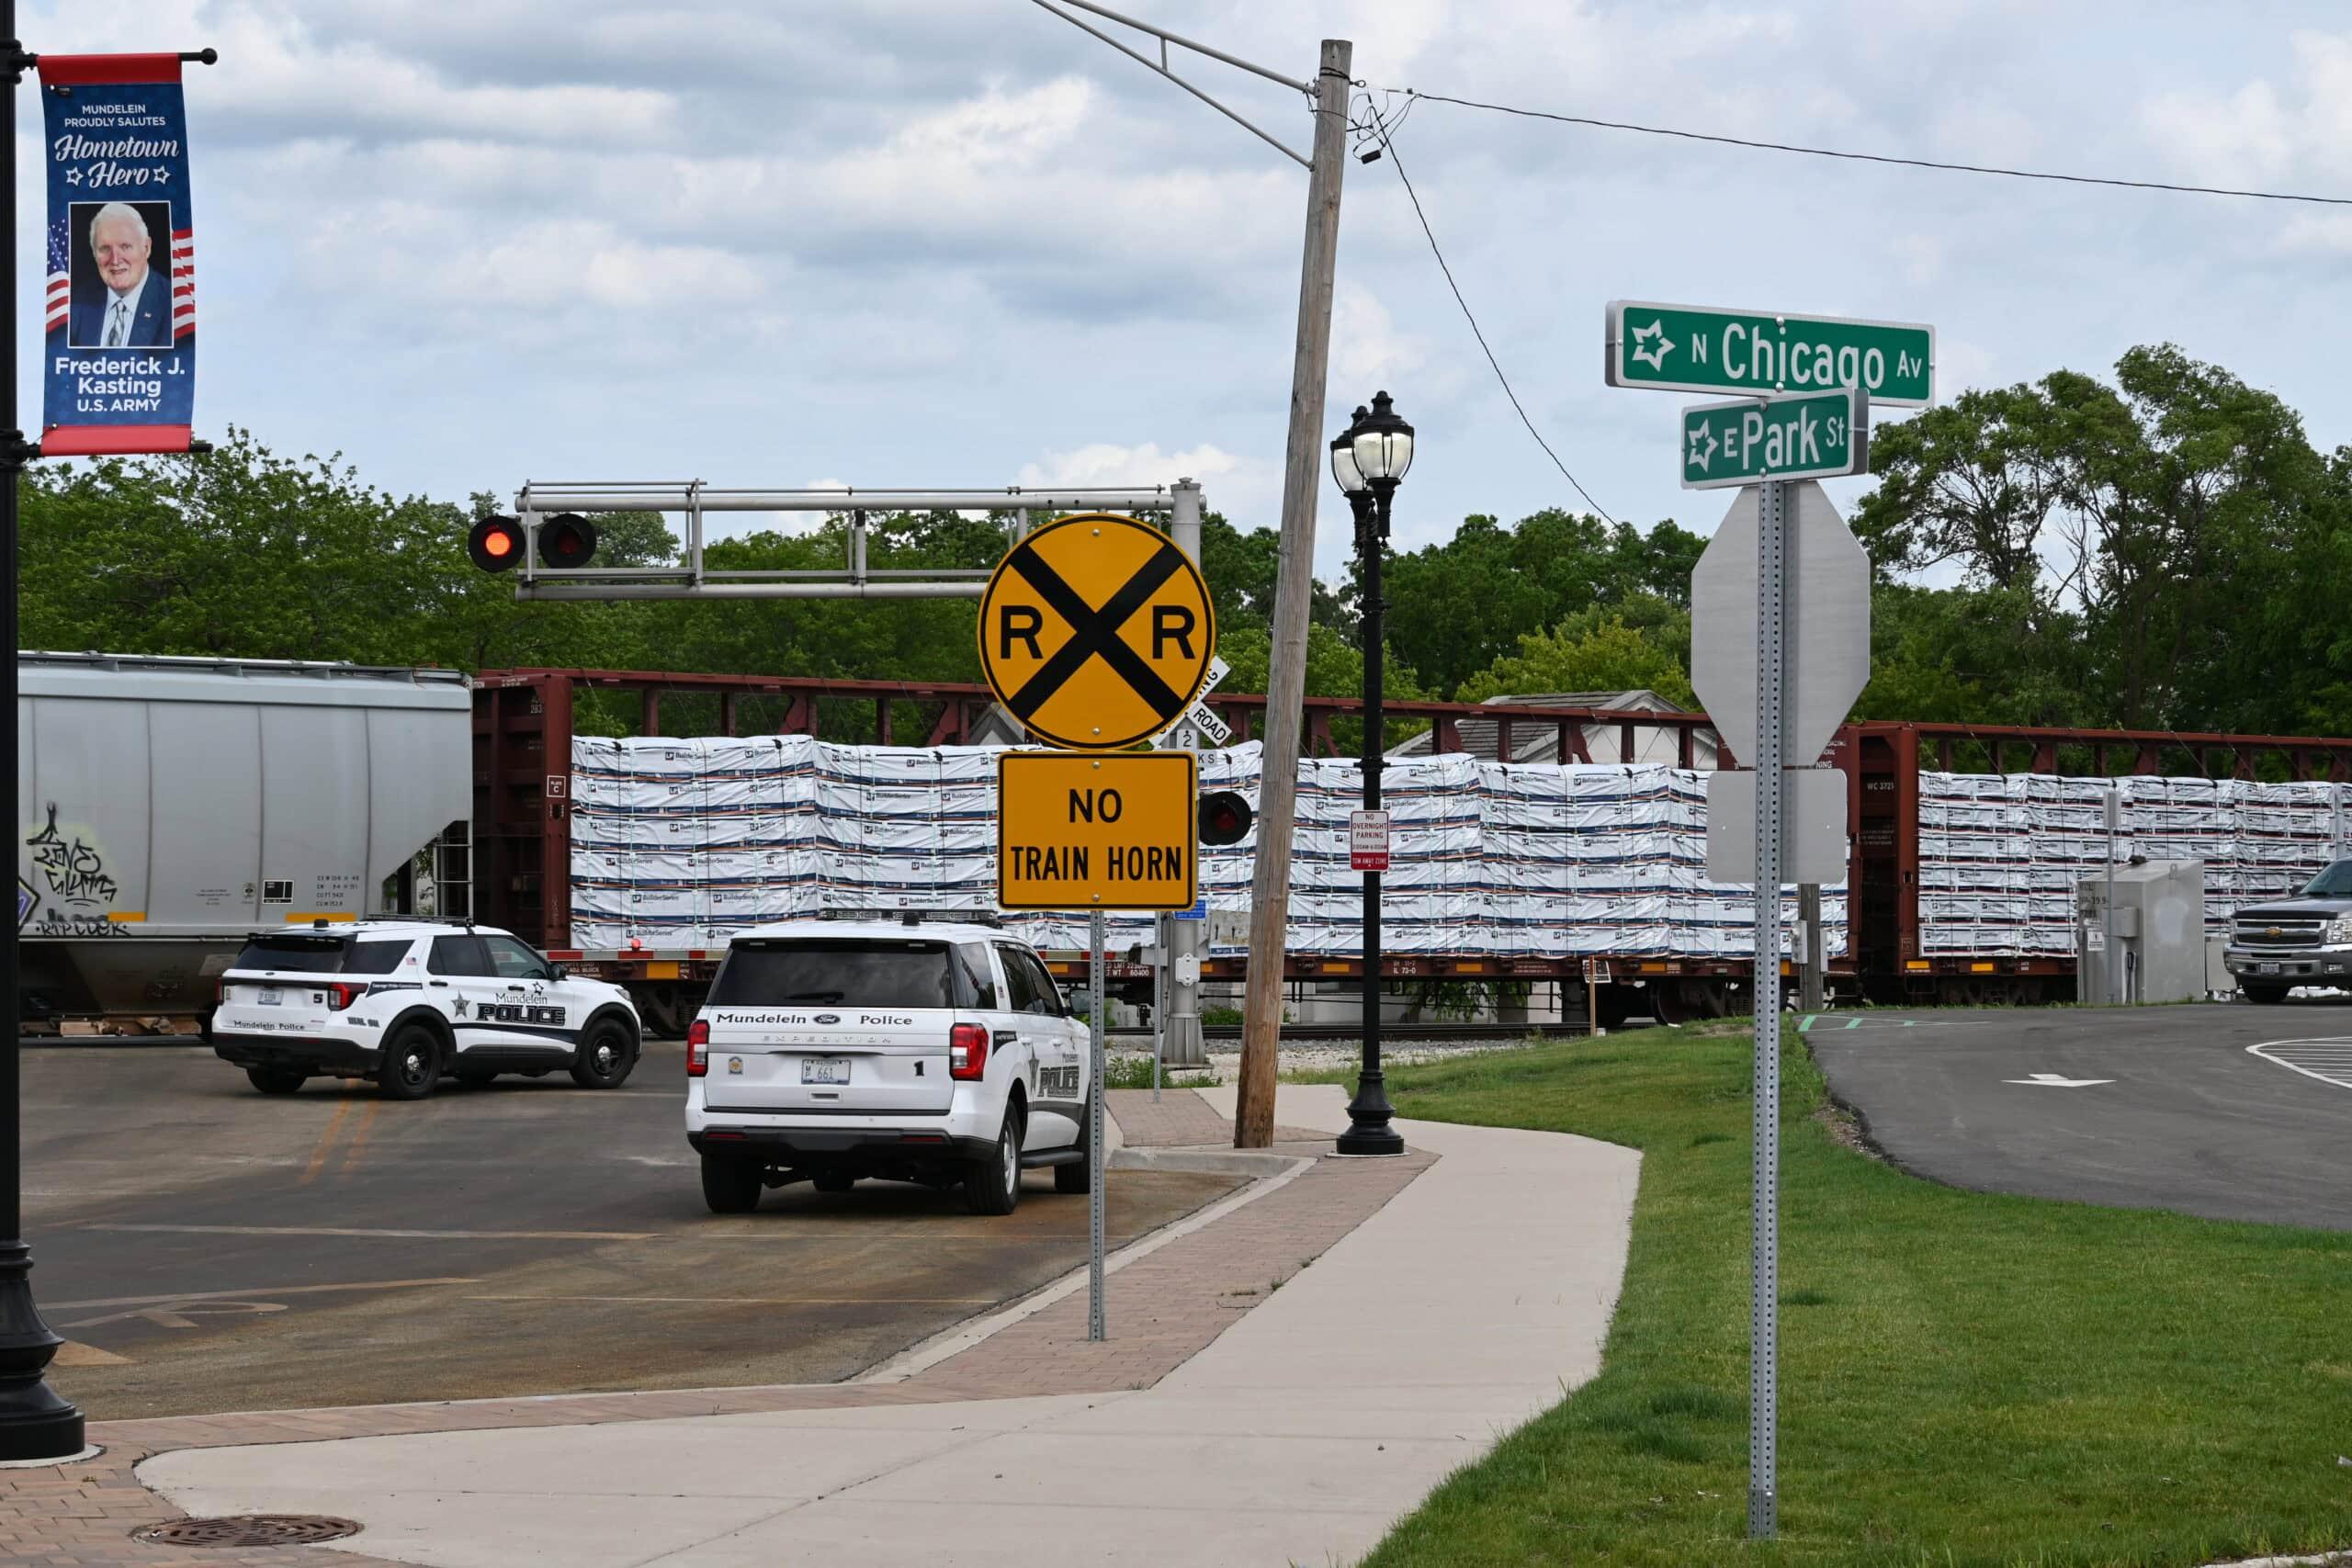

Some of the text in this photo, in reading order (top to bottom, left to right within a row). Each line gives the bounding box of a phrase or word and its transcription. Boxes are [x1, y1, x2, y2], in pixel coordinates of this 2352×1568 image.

[82, 104, 146, 115] MUNDELEIN
[64, 117, 166, 128] PROUDLY SALUTES
[54, 134, 180, 162] Hometown
[87, 161, 150, 188] Hero
[55, 356, 186, 376] Frederick J.
[1691, 322, 1923, 389] N Chicago Av
[77, 377, 162, 398] Kasting
[77, 399, 162, 412] U.S. ARMY
[1724, 405, 1845, 470] E Park St
[1000, 605, 1195, 660] R R
[1193, 707, 1227, 741] ROAD
[1182, 734, 1193, 748] 2
[1069, 788, 1123, 824] NO
[1011, 846, 1182, 882] TRAIN HORN
[495, 992, 548, 1005] Mundelein
[476, 1002, 566, 1026] POLICE
[716, 1013, 913, 1026] Mundelein Police
[233, 1020, 306, 1031] Mundelein Police
[913, 1060, 925, 1077] 1
